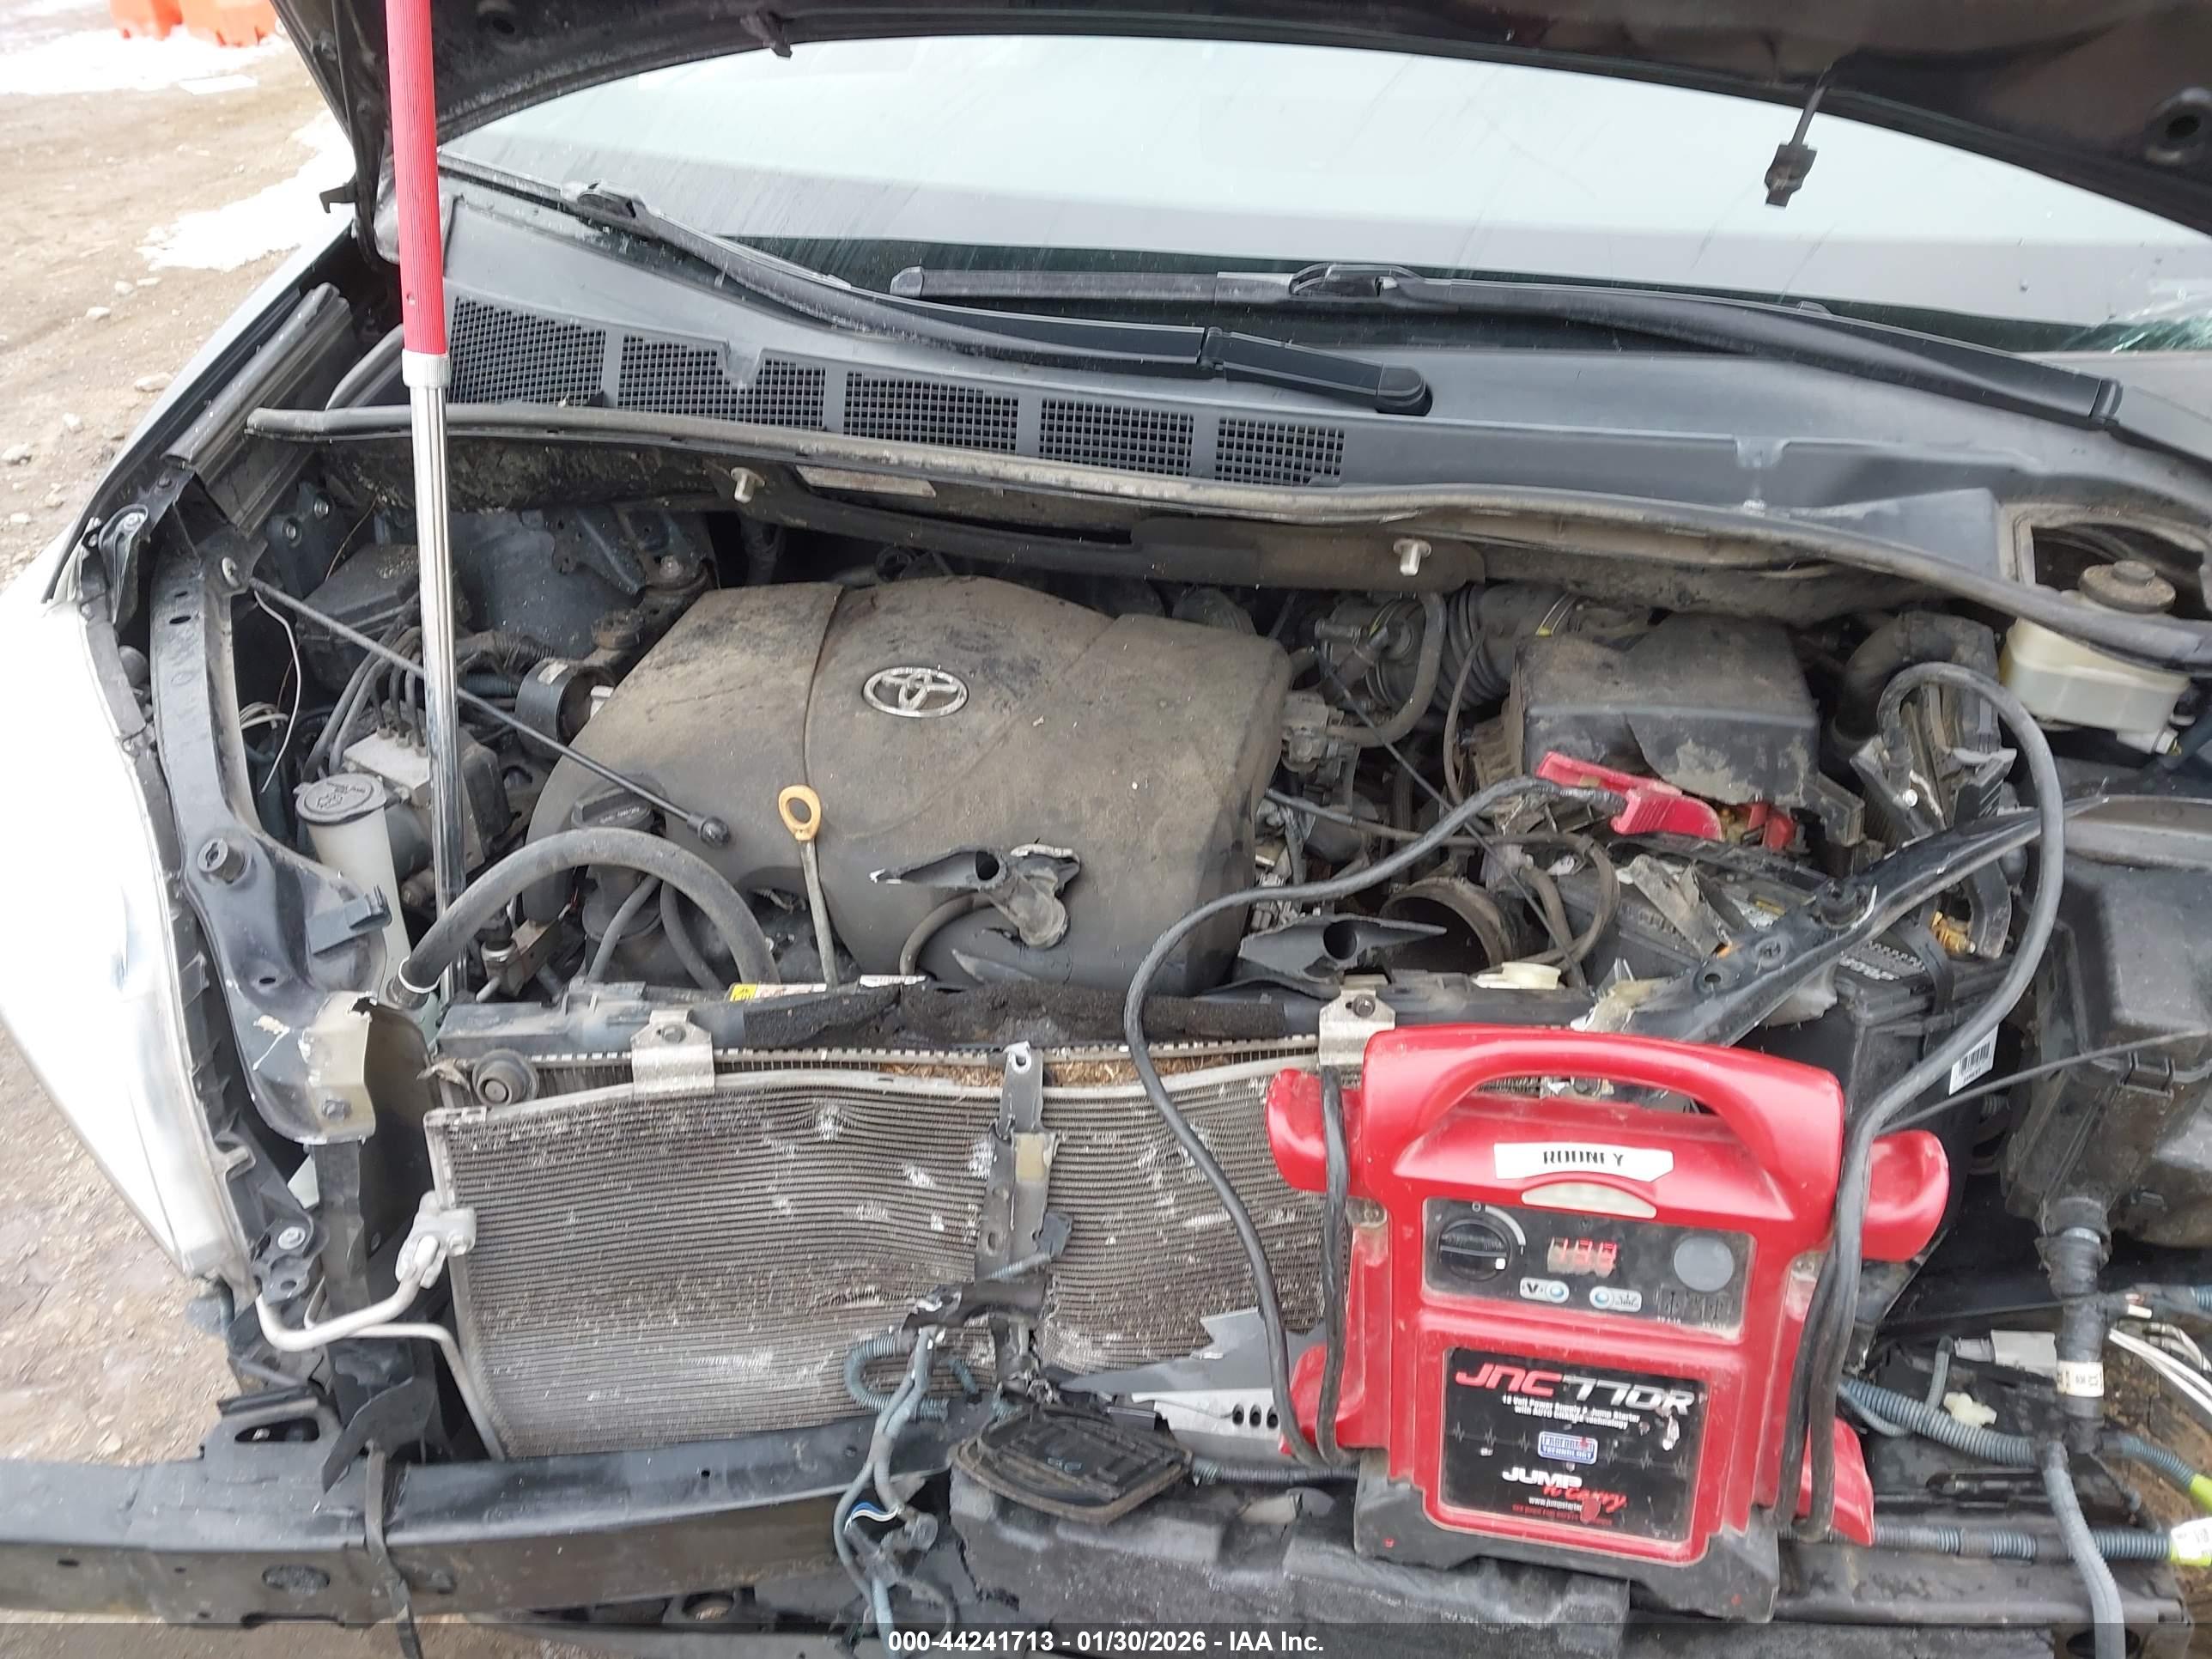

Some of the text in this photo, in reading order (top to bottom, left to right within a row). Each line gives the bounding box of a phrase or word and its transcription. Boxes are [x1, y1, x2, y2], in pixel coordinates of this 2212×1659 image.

[1542, 1150, 1624, 1167] RODNEY
[1528, 1397, 1553, 1413] Power
[1554, 1401, 1581, 1419] Supply
[1590, 1407, 1612, 1421] Jump
[1613, 1410, 1641, 1424] Starter
[1502, 1466, 1583, 1490] JUMP
